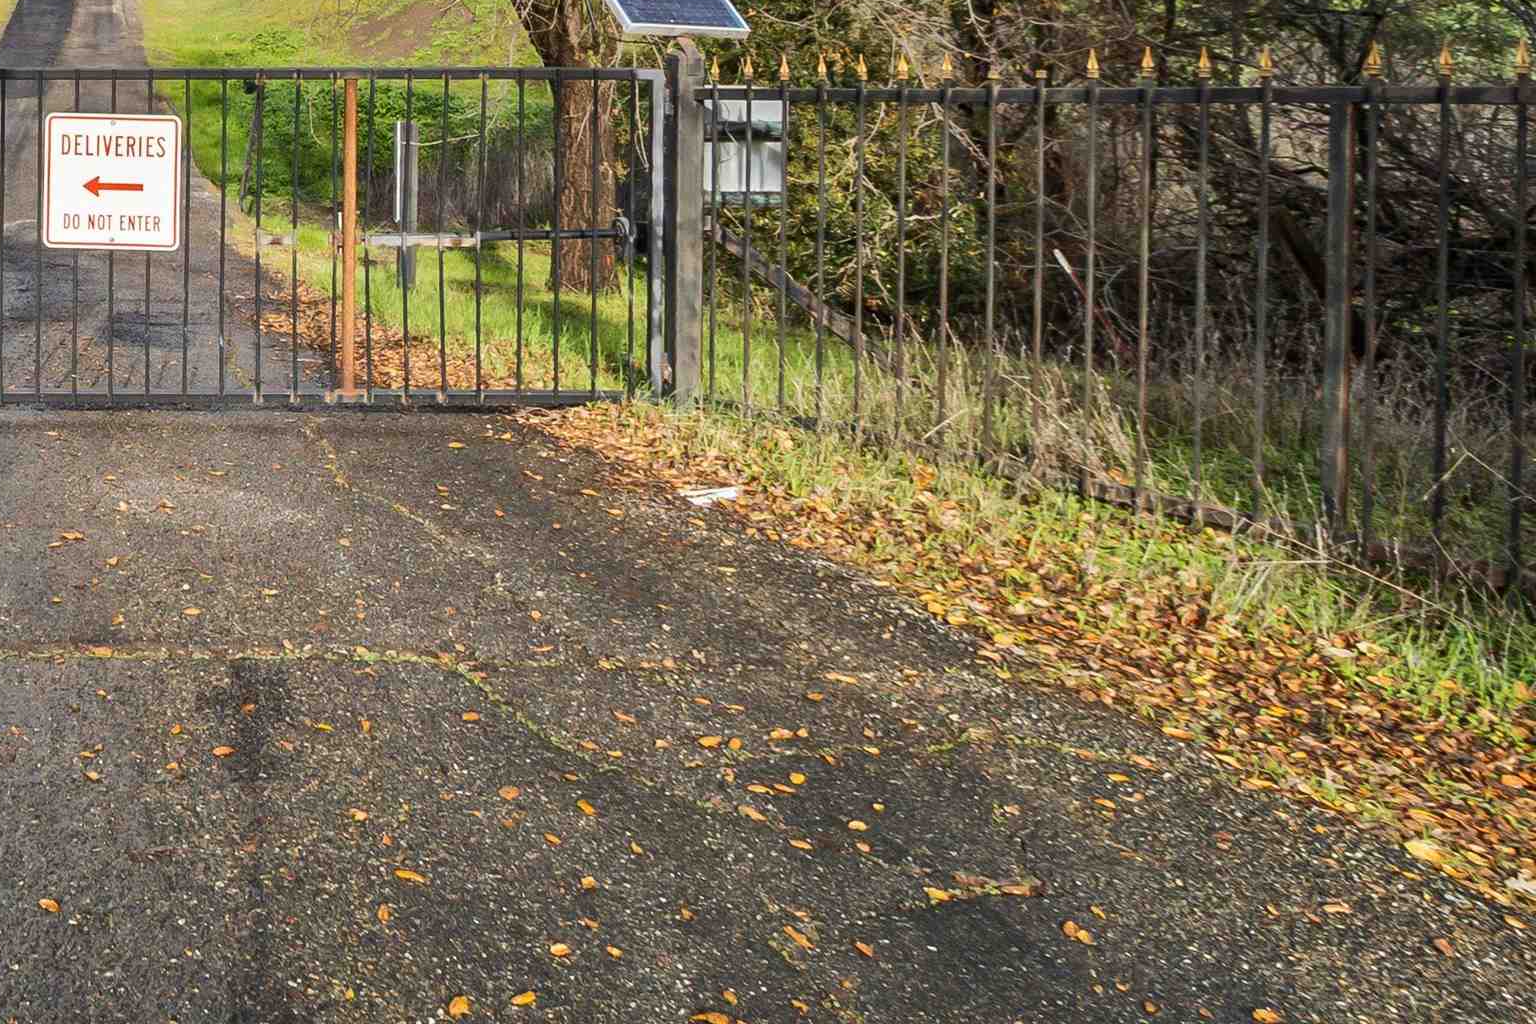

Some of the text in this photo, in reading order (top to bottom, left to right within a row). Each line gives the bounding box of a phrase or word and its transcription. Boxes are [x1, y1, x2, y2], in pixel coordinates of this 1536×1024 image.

[61, 134, 166, 158] DELIVERIES
[64, 213, 161, 232] DO NOT ENTER
